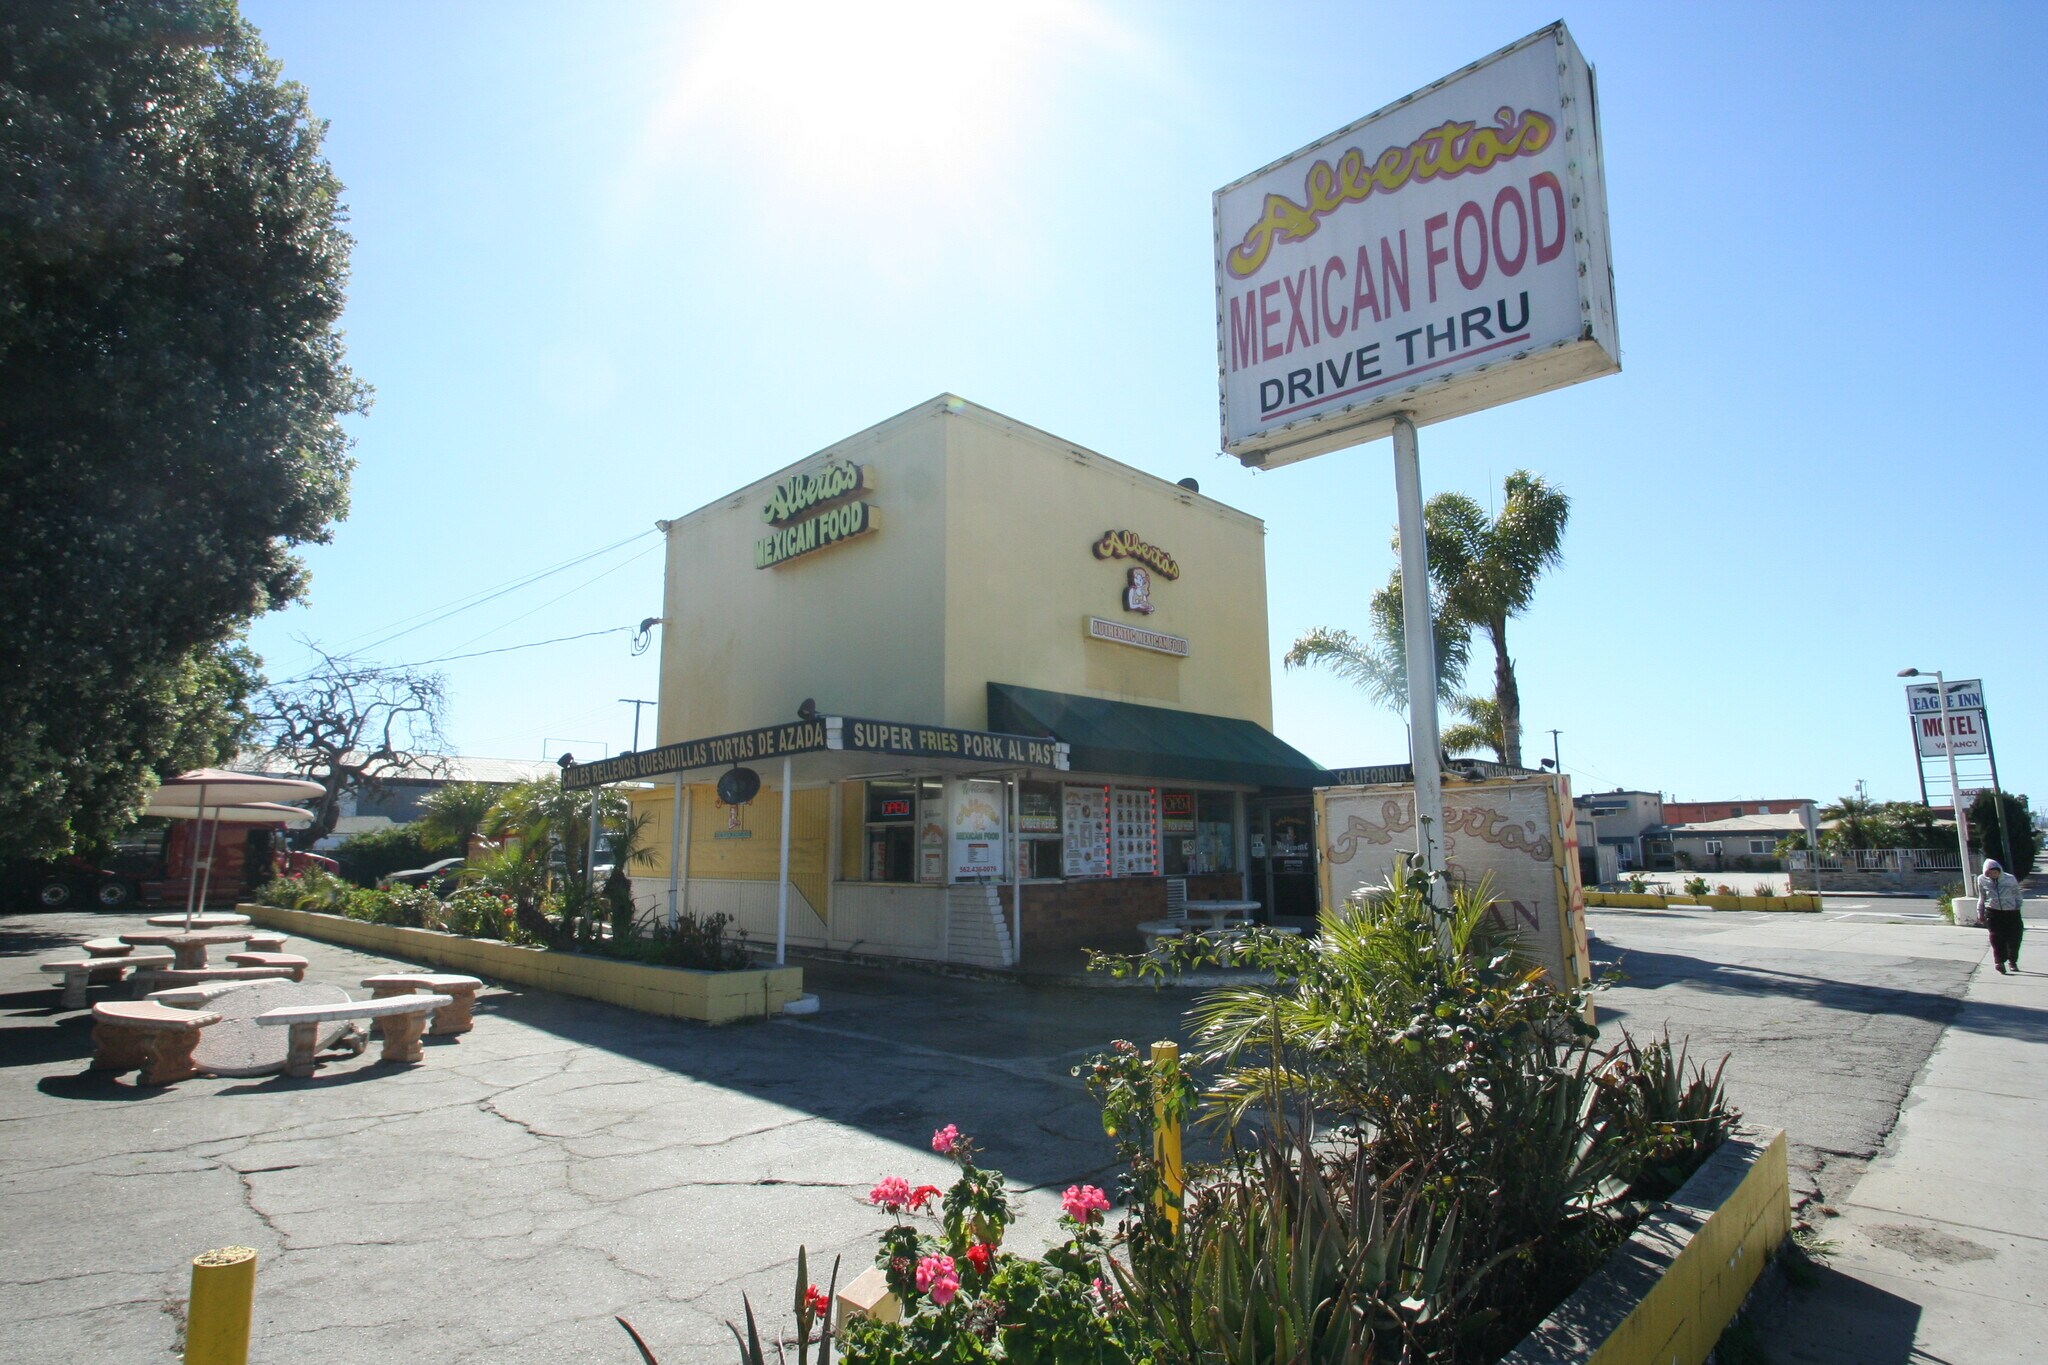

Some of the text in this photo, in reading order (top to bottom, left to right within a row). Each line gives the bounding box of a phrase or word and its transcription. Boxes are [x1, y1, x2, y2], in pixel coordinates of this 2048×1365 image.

[1227, 106, 1555, 280] Alberto's
[1230, 171, 1565, 372] MEXICAN FOOD
[1260, 291, 1530, 413] DRIVE THRU
[755, 500, 864, 569] MEXICAN FOOD
[1093, 619, 1188, 654] AUTHENTIC MEXICAN FOOD
[1912, 693, 1981, 710] EAGE INN
[562, 768, 591, 789] CHILES
[592, 757, 637, 783] RELLENOS
[639, 746, 707, 775] QUESADILLAS
[710, 734, 754, 764] TORTAS
[758, 731, 774, 755] DE
[854, 722, 913, 750] SUPER
[919, 730, 958, 752] FRIES
[964, 733, 1003, 759] PORK
[1008, 740, 1025, 762] AL
[1935, 740, 1978, 749] VAANCY
[1338, 767, 1407, 785] CALIFORNIA
[884, 801, 908, 814] OPEN
[984, 832, 1000, 841] FOOD
[1327, 800, 1554, 864] Alerto's
